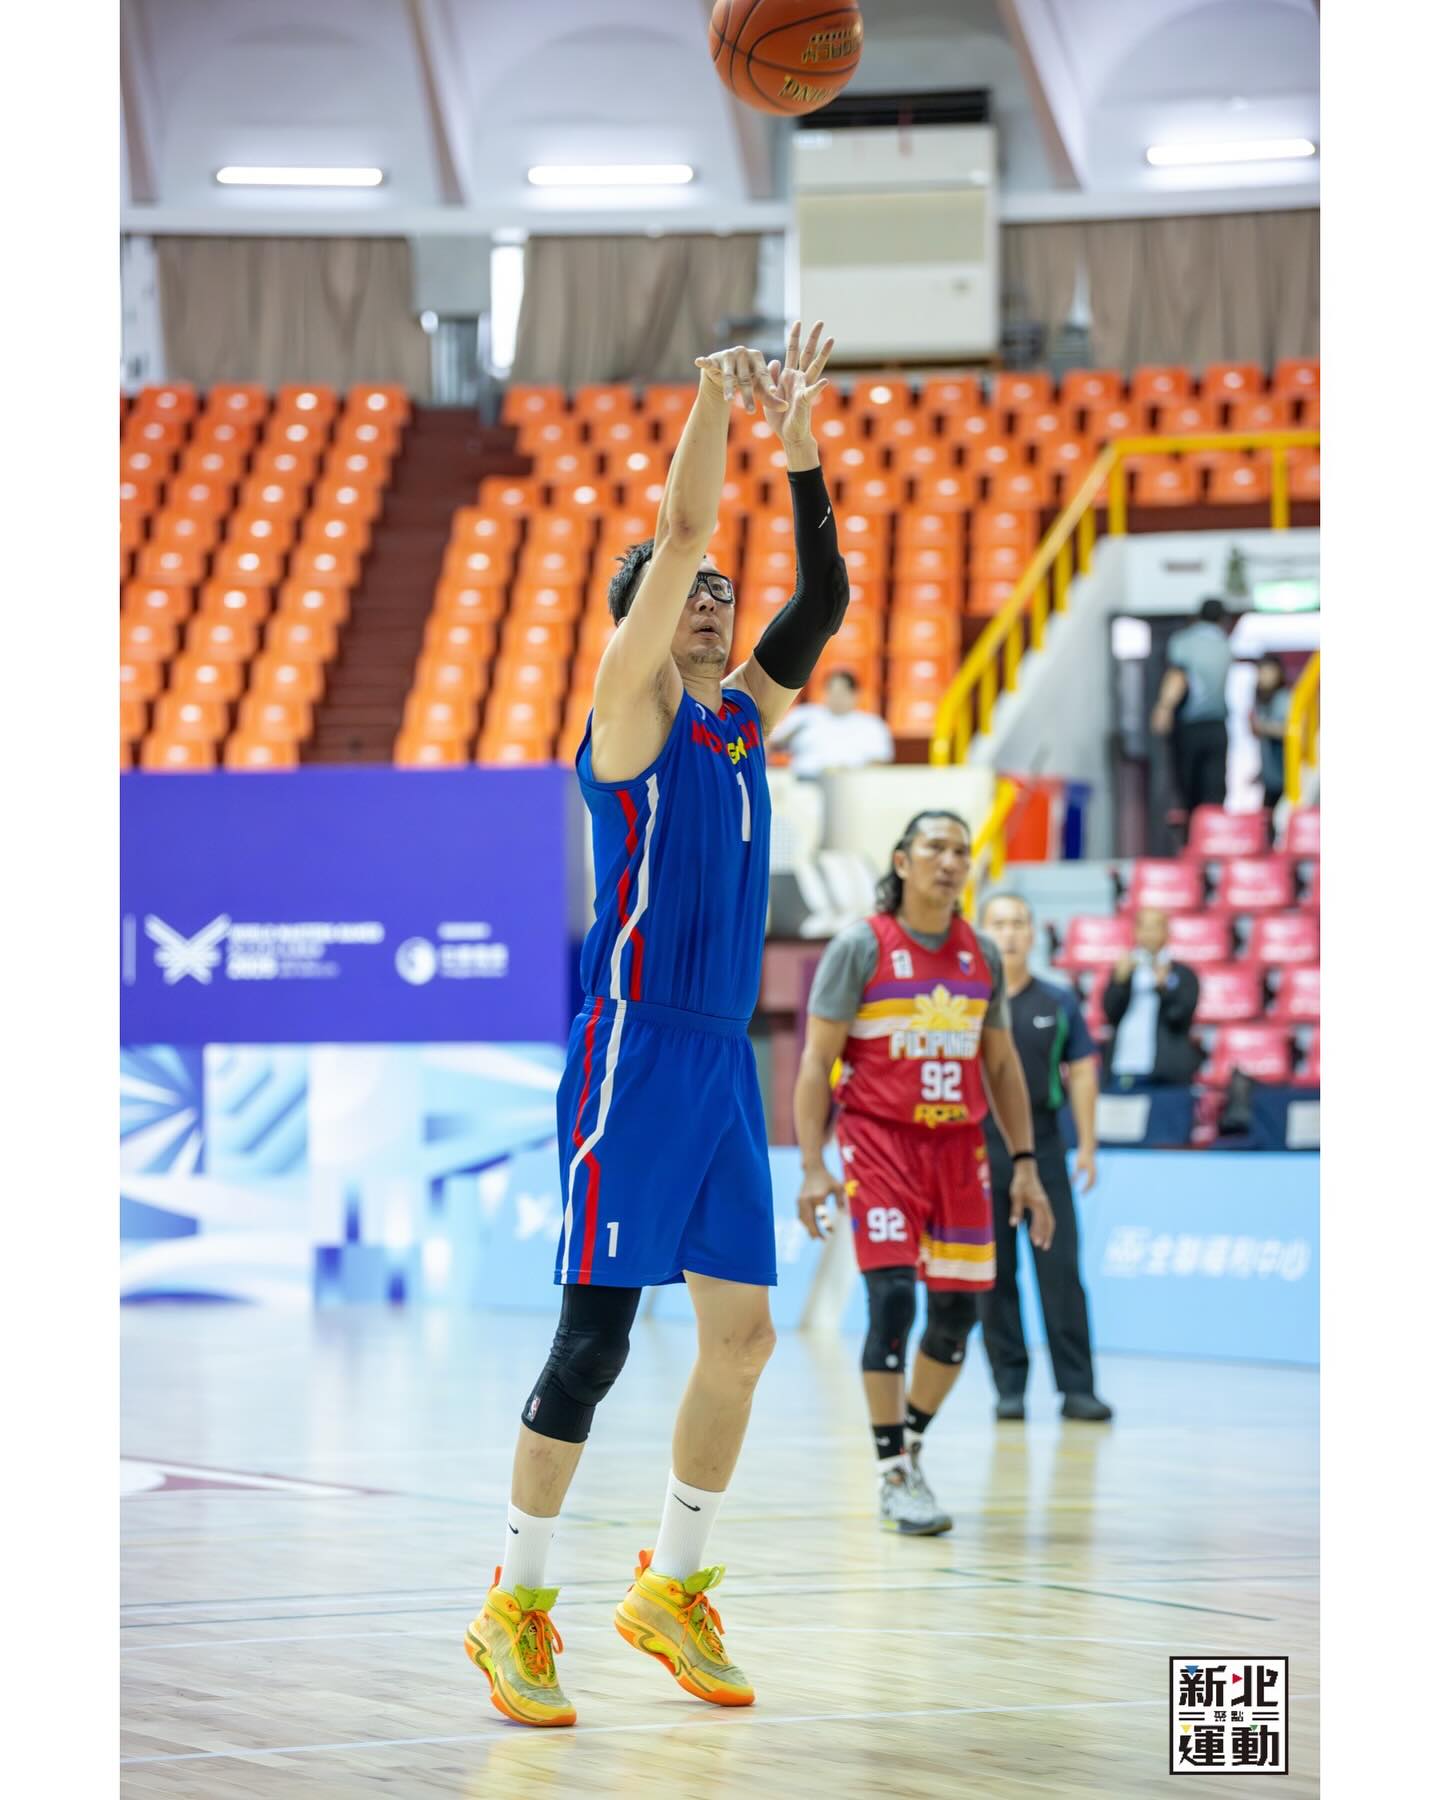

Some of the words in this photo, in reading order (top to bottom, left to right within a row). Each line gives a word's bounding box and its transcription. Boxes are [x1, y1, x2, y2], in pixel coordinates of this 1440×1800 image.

[736, 771, 752, 842] 1
[920, 1060, 963, 1101] 92
[606, 1221, 620, 1258] 1
[866, 1206, 908, 1243] 92
